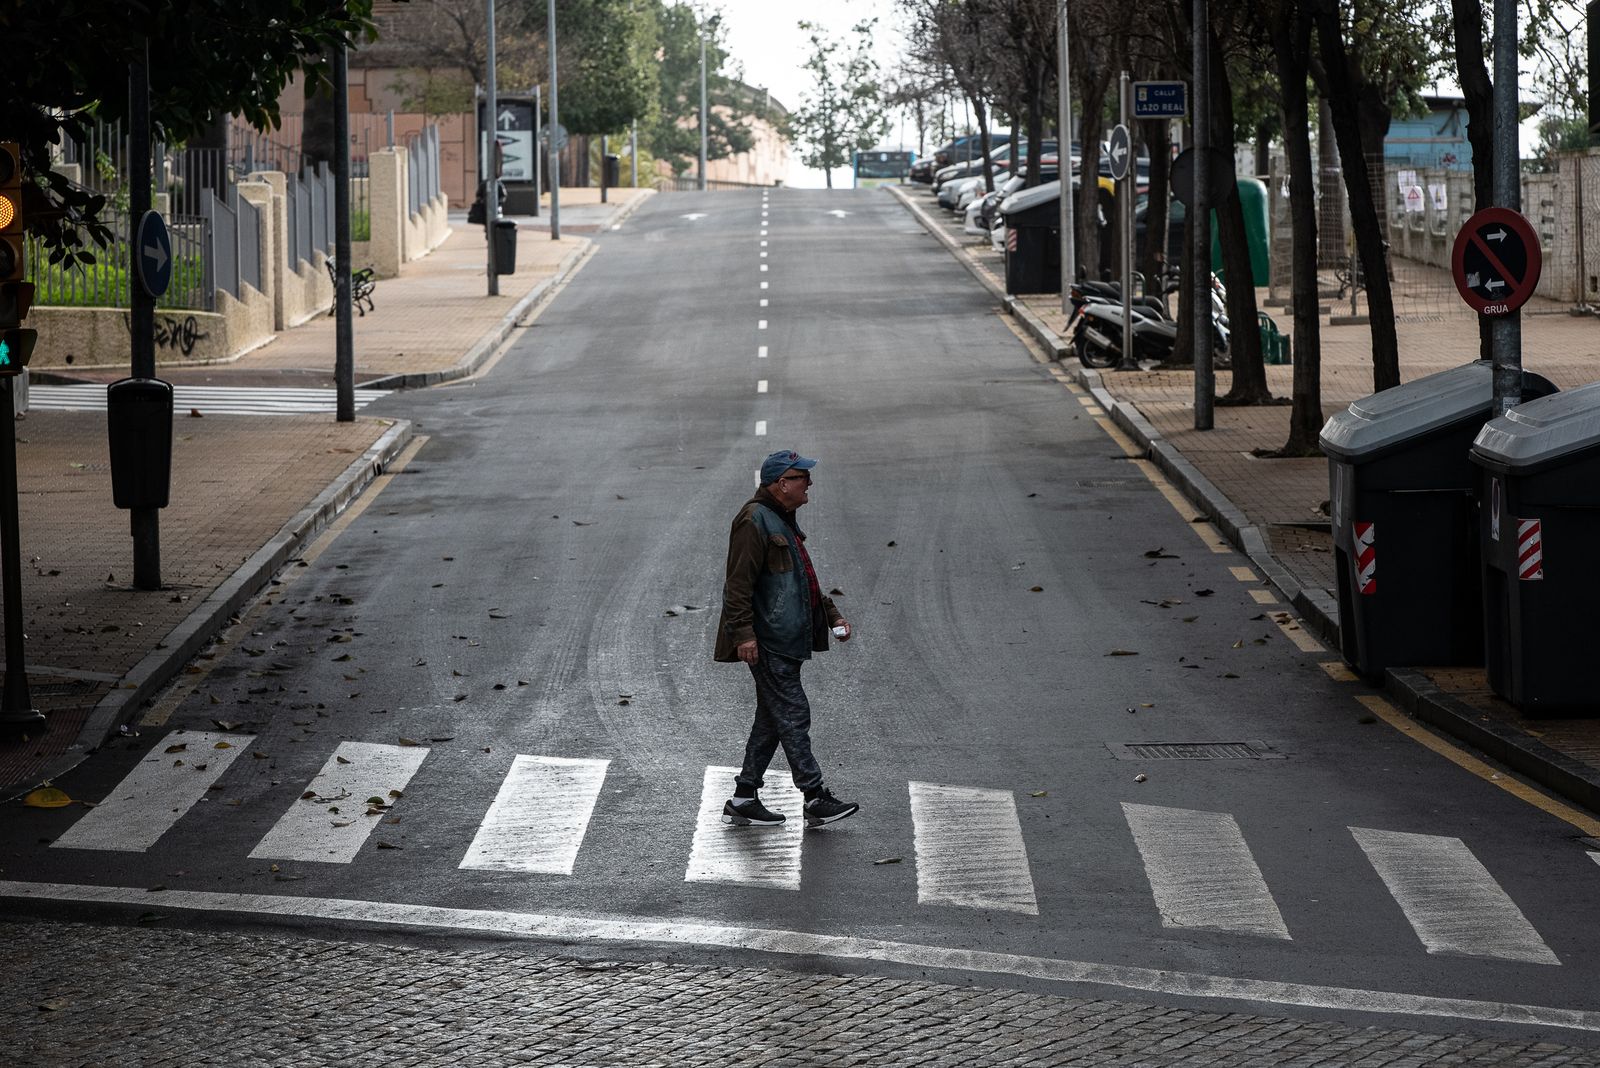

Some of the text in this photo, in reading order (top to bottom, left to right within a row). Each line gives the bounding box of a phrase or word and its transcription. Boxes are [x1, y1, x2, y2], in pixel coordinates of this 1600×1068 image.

[1137, 103, 1184, 112] LAZO REAL
[1484, 304, 1509, 314] GRUA
